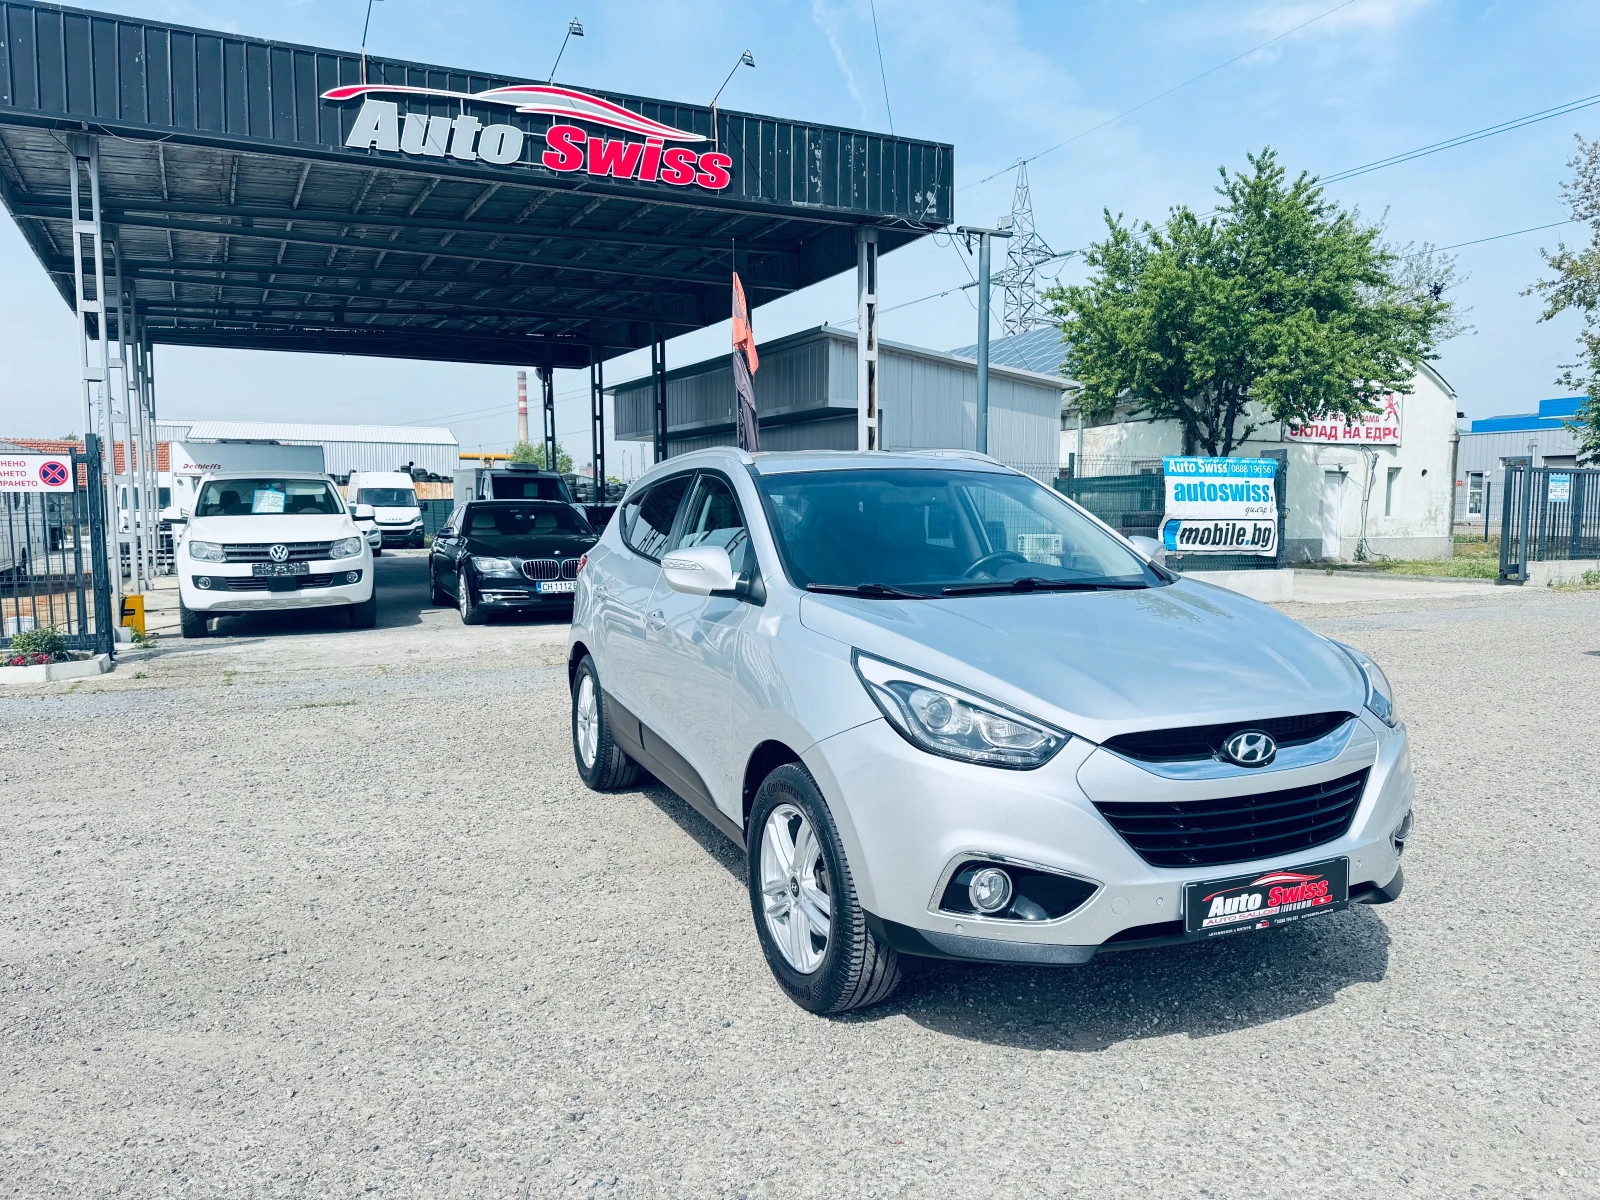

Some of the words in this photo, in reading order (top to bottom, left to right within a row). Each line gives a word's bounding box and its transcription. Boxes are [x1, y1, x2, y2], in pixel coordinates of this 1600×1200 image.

[345, 98, 524, 165] Auto
[542, 124, 732, 190] Swiss
[1343, 426, 1361, 439] НА
[1169, 460, 1196, 473] Auto
[1198, 460, 1228, 473] Swiss
[1231, 464, 1248, 473] 0888
[1250, 464, 1261, 473] 196
[1263, 465, 1274, 474] 561
[1179, 523, 1272, 548] mobile.bg
[1208, 893, 1262, 918] Auto
[1268, 880, 1328, 906] Swiss
[1206, 915, 1237, 925] AUTO
[1239, 908, 1278, 919] SALLON
